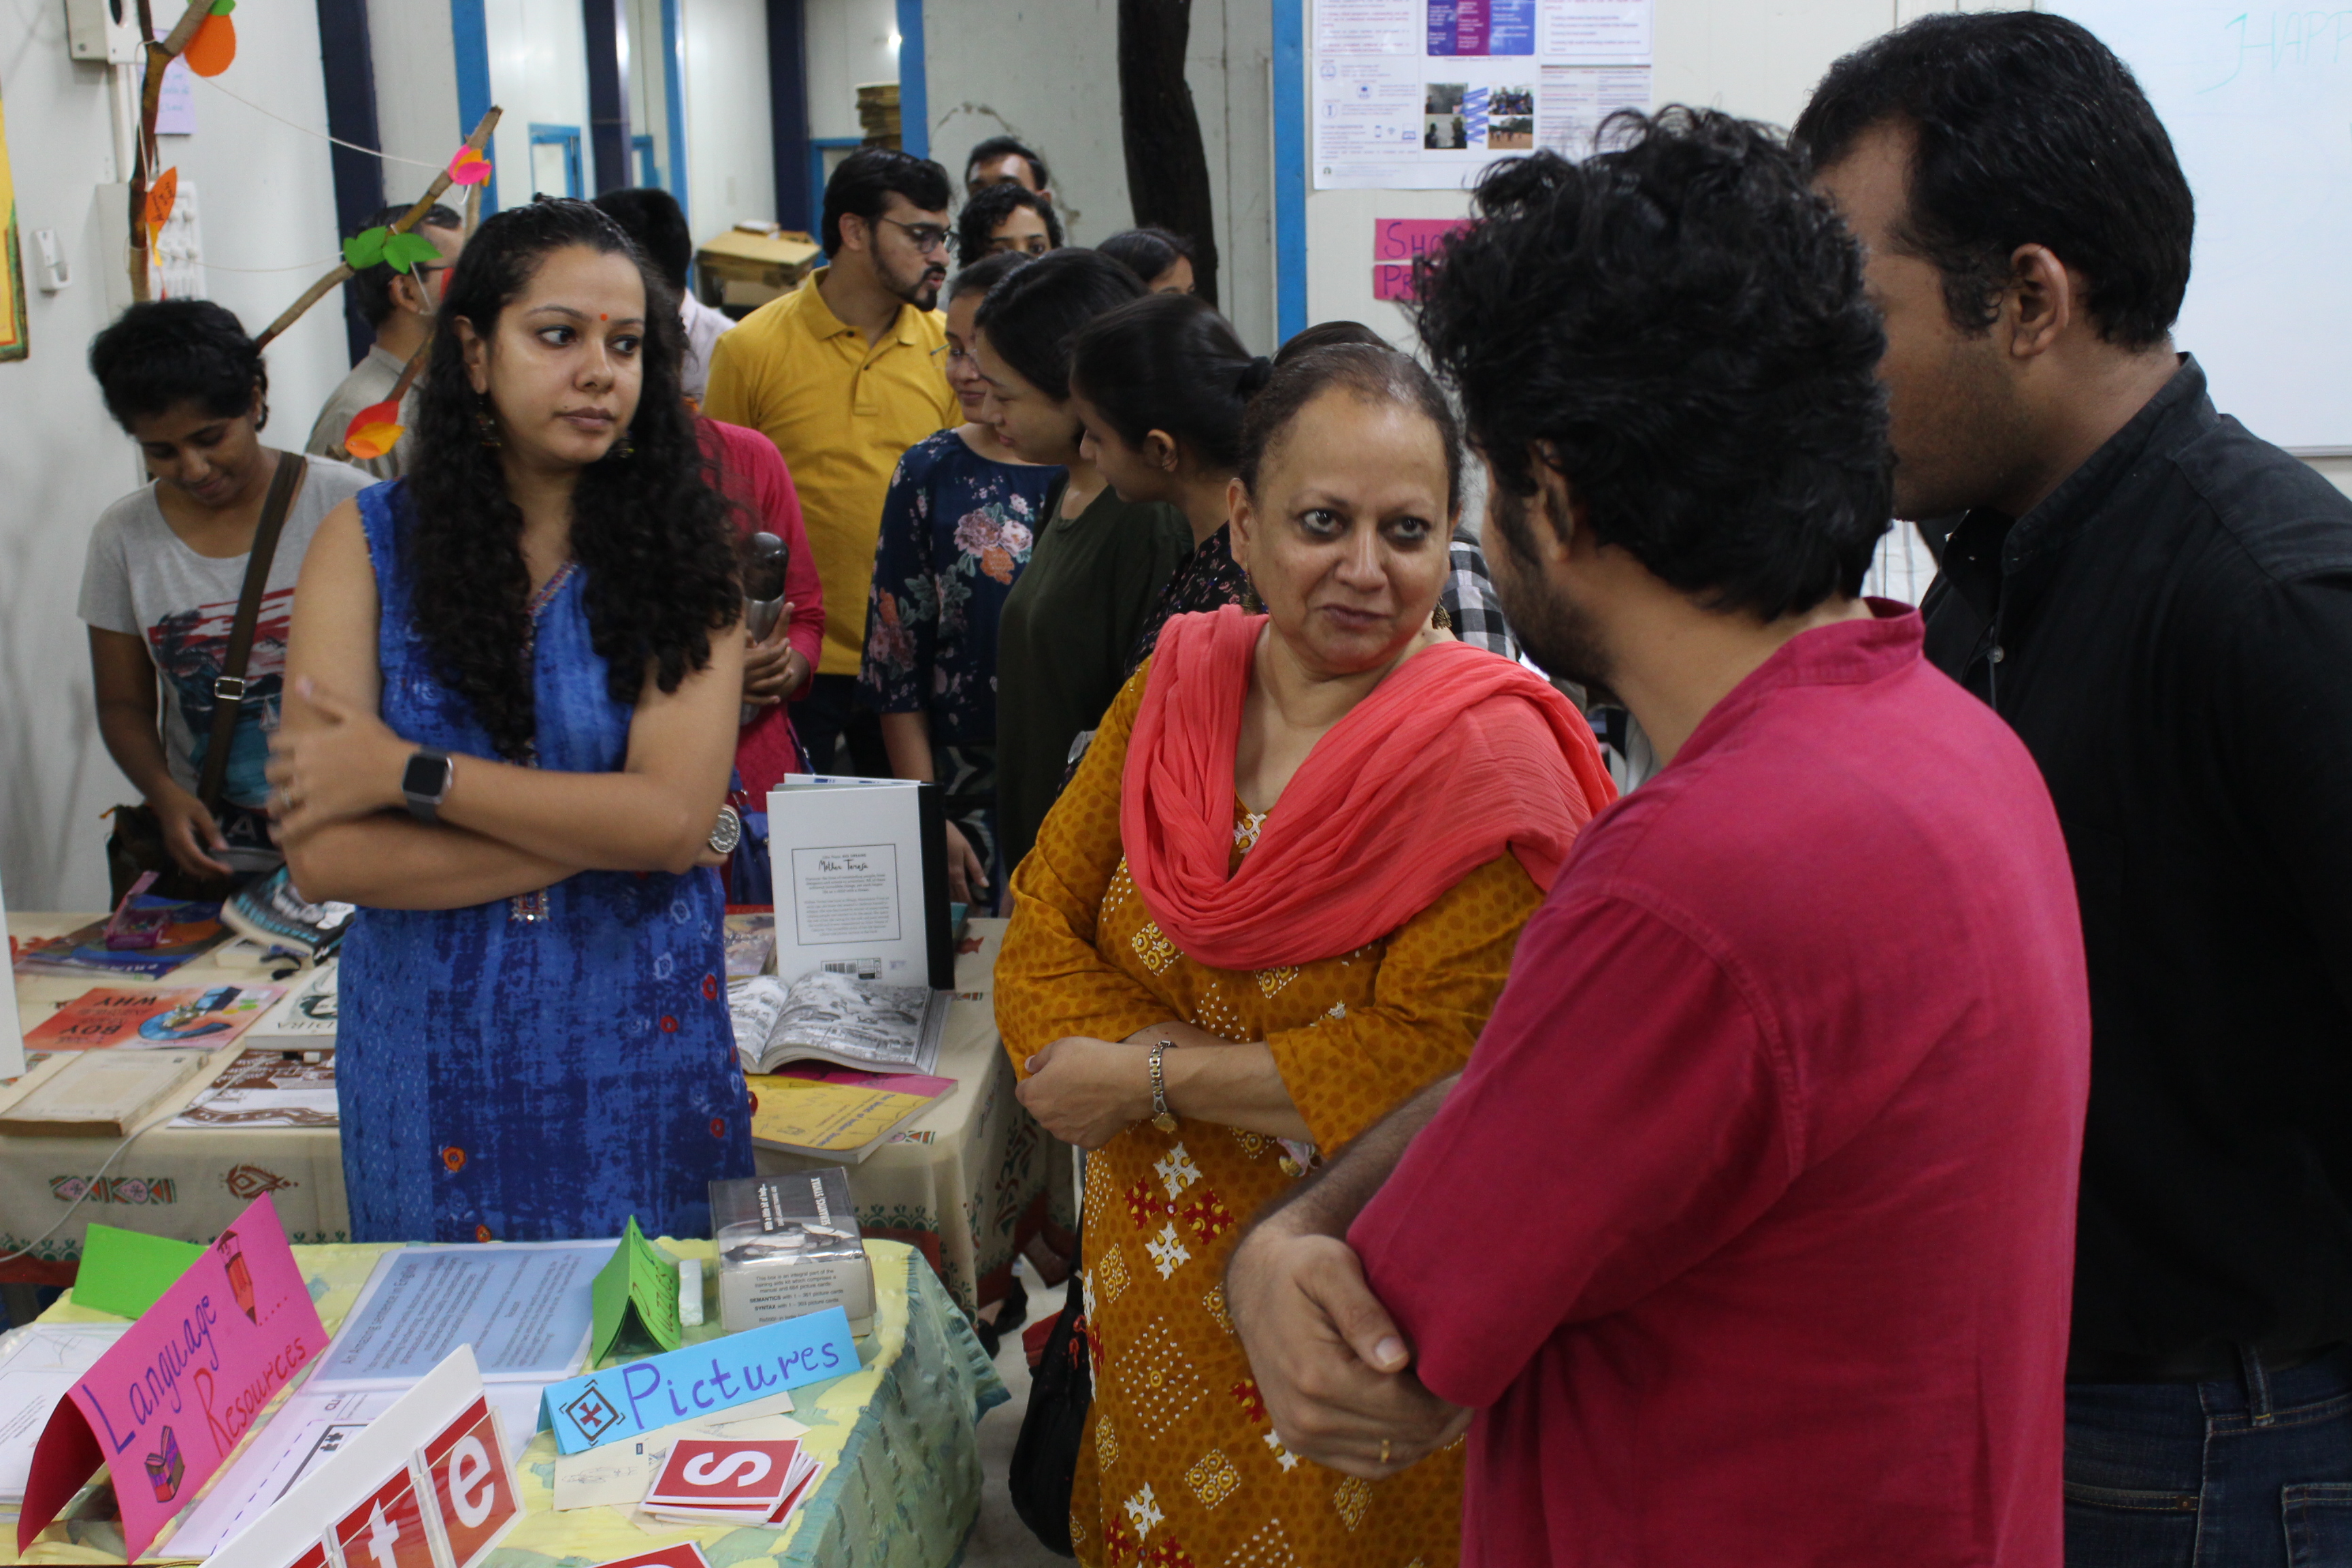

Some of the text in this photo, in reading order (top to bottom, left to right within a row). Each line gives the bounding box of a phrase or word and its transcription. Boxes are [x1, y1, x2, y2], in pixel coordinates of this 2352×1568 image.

[819, 859, 868, 872] Mother Teresa
[93, 996, 157, 1007] WHY
[59, 1024, 122, 1034] BOY
[348, 1325, 382, 1354] Amazing
[80, 1294, 218, 1456] Language
[621, 1341, 840, 1430] Pictures
[193, 1337, 307, 1458] Resources
[682, 1450, 773, 1488] S
